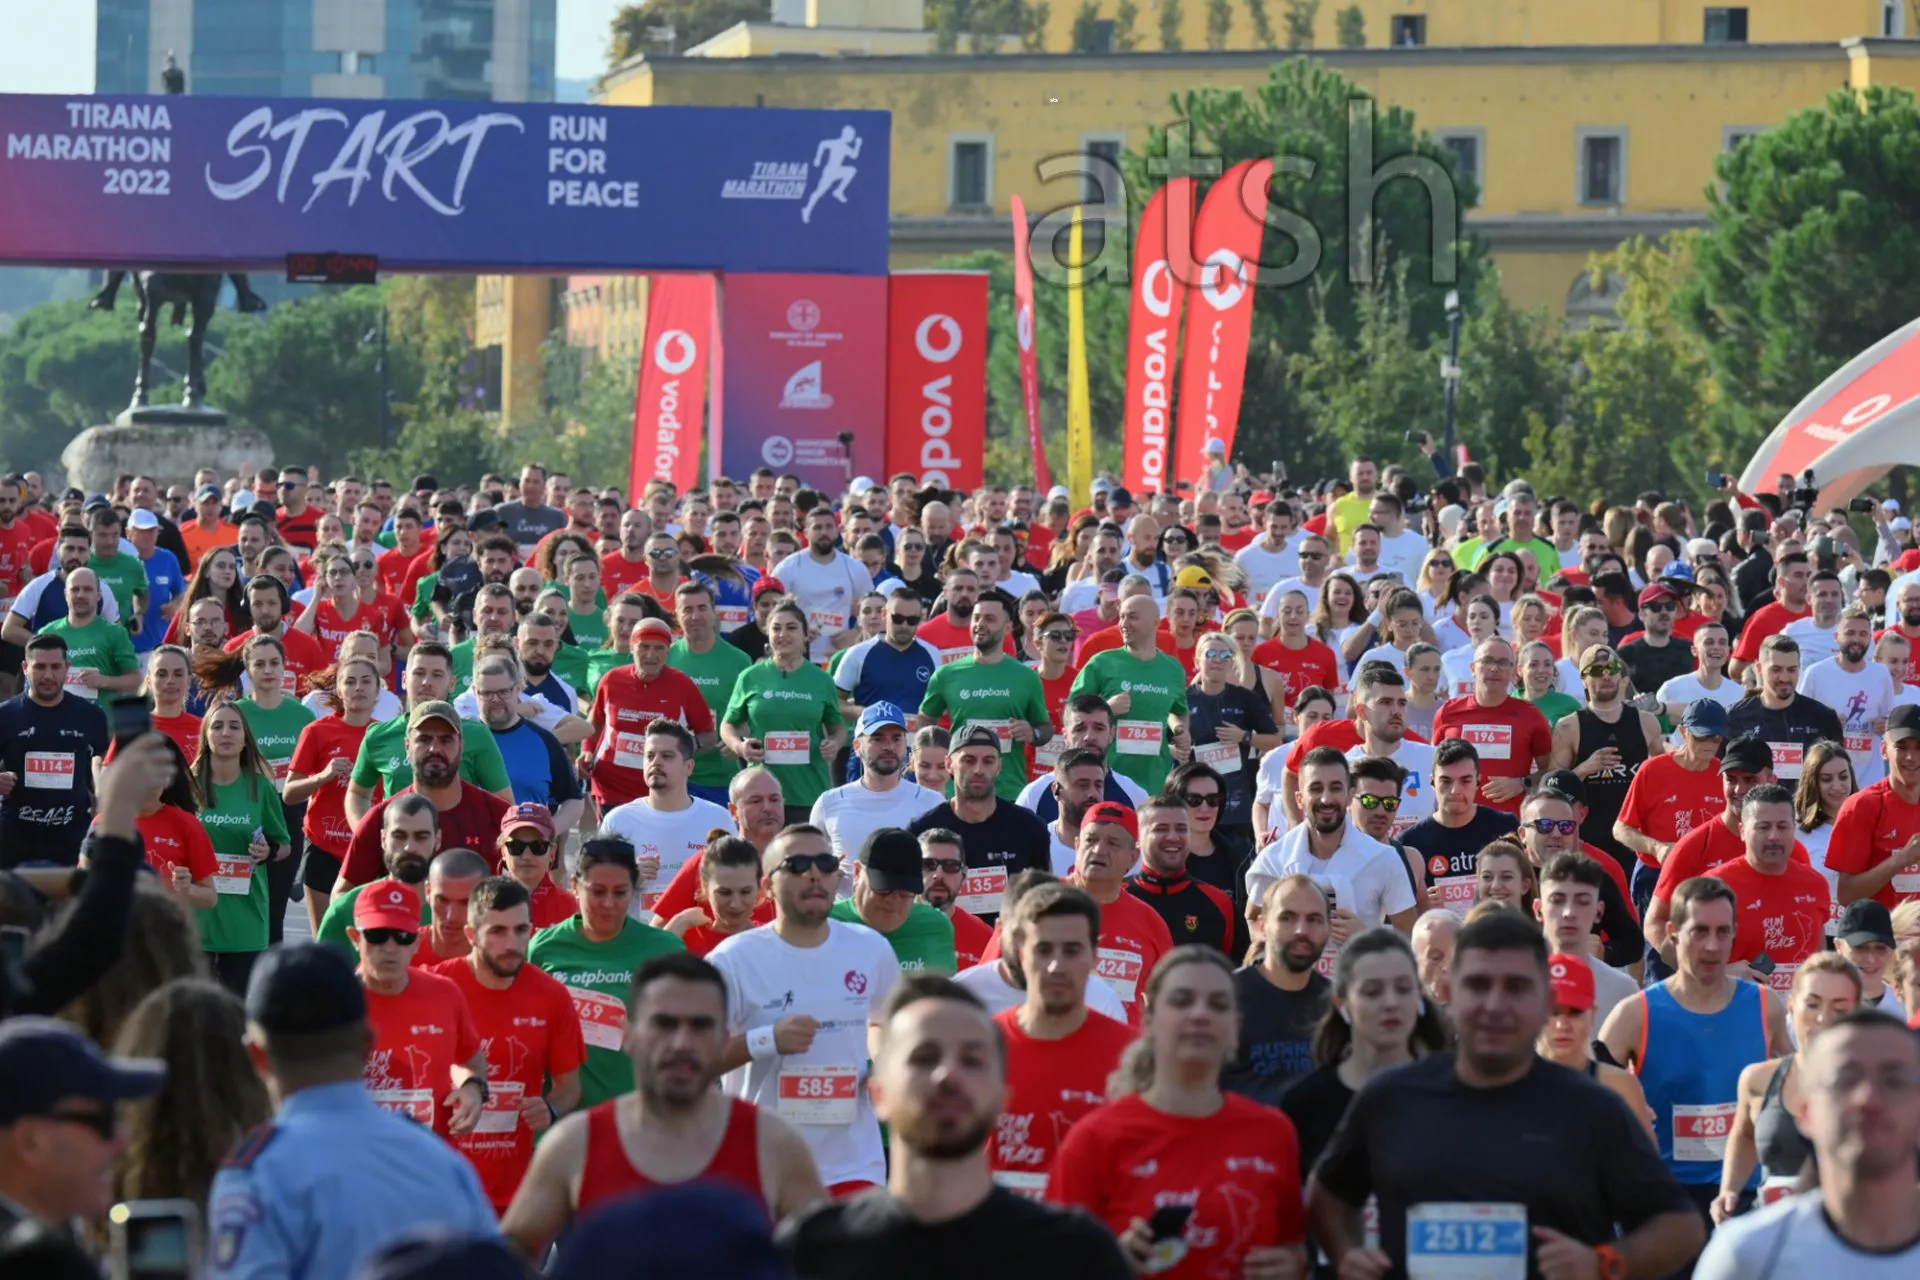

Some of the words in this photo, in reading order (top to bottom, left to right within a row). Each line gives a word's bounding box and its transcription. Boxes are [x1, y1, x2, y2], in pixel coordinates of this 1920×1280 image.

[66, 103, 171, 130] TIRANA
[549, 116, 607, 142] RUN
[7, 134, 171, 163] MARATHON
[205, 106, 525, 216] START
[549, 148, 606, 174] FOR
[753, 162, 809, 178] TIRANA
[103, 168, 170, 195] 2022
[722, 180, 807, 198] MARATHON
[548, 180, 639, 208] PEACE
[517, 519, 548, 535] Google
[774, 690, 813, 702] otpbank
[972, 688, 1010, 699] otpbank
[1132, 684, 1169, 696] otpbank
[257, 736, 297, 748] otpbank
[1127, 729, 1149, 740] 786
[1473, 731, 1496, 743] 196
[775, 738, 796, 750] 736
[32, 759, 63, 772] 1114
[205, 812, 251, 827] otpbank
[1762, 916, 1784, 930] RUN
[1765, 927, 1784, 938] FOR
[1765, 936, 1796, 950] PEACE
[1096, 959, 1127, 977] 424
[571, 969, 633, 987] otpbank
[797, 1078, 835, 1096] 585
[1691, 1117, 1726, 1134] 428
[474, 1140, 516, 1149] MARATHON
[1424, 1223, 1497, 1251] 2512
